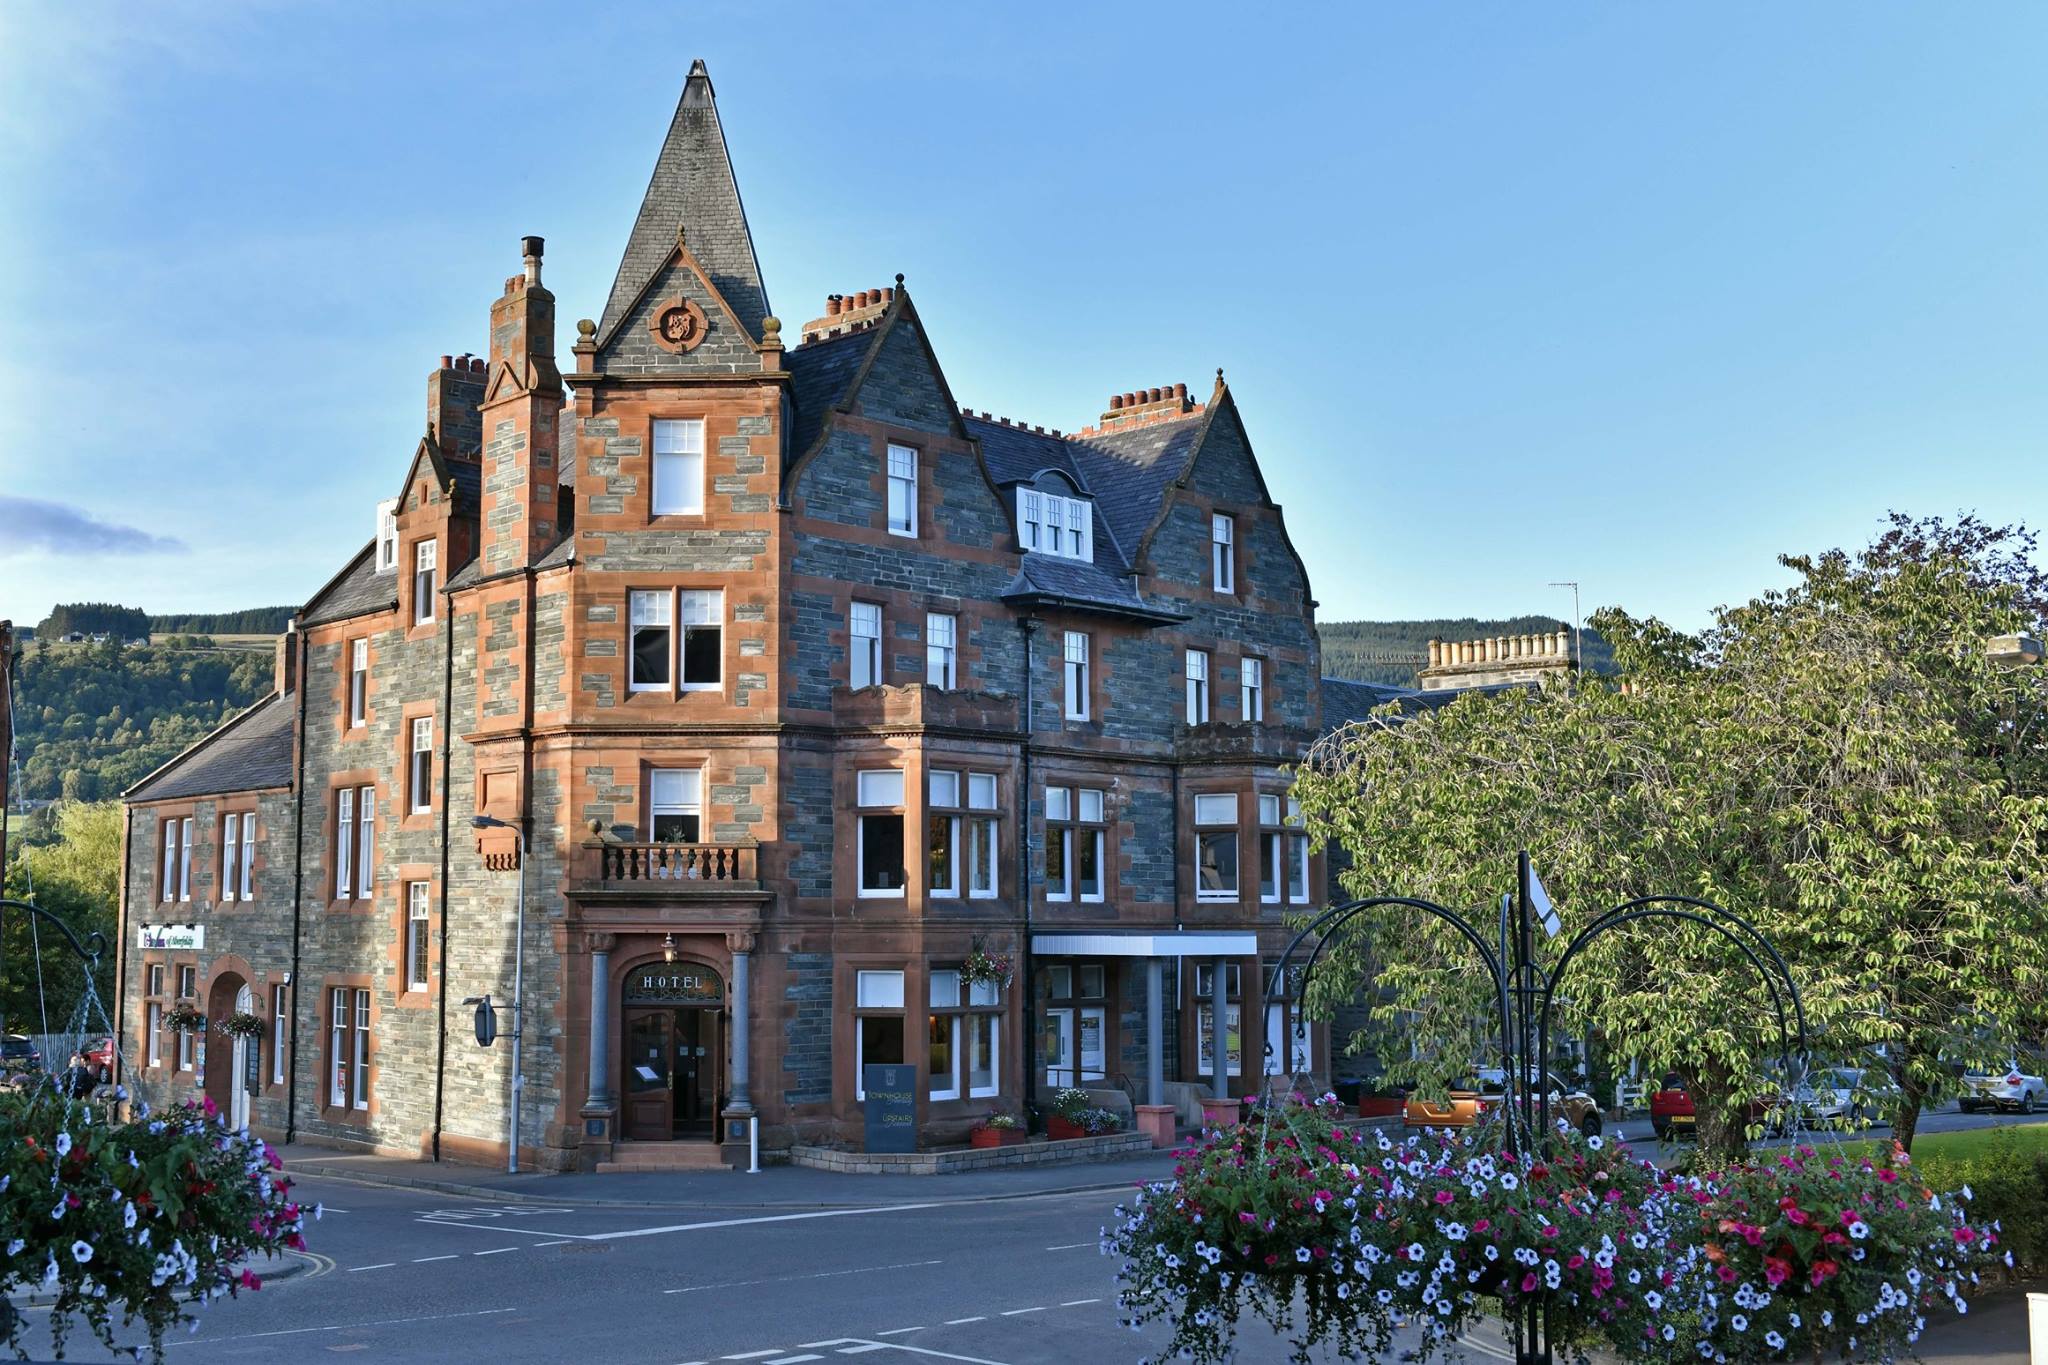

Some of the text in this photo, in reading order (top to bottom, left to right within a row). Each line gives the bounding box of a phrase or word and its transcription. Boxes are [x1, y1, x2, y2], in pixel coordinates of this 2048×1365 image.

[643, 976, 703, 989] HOTEL
[868, 1091, 912, 1100] TOWNHOUSE
[883, 1113, 912, 1122] UPSTAIRS
